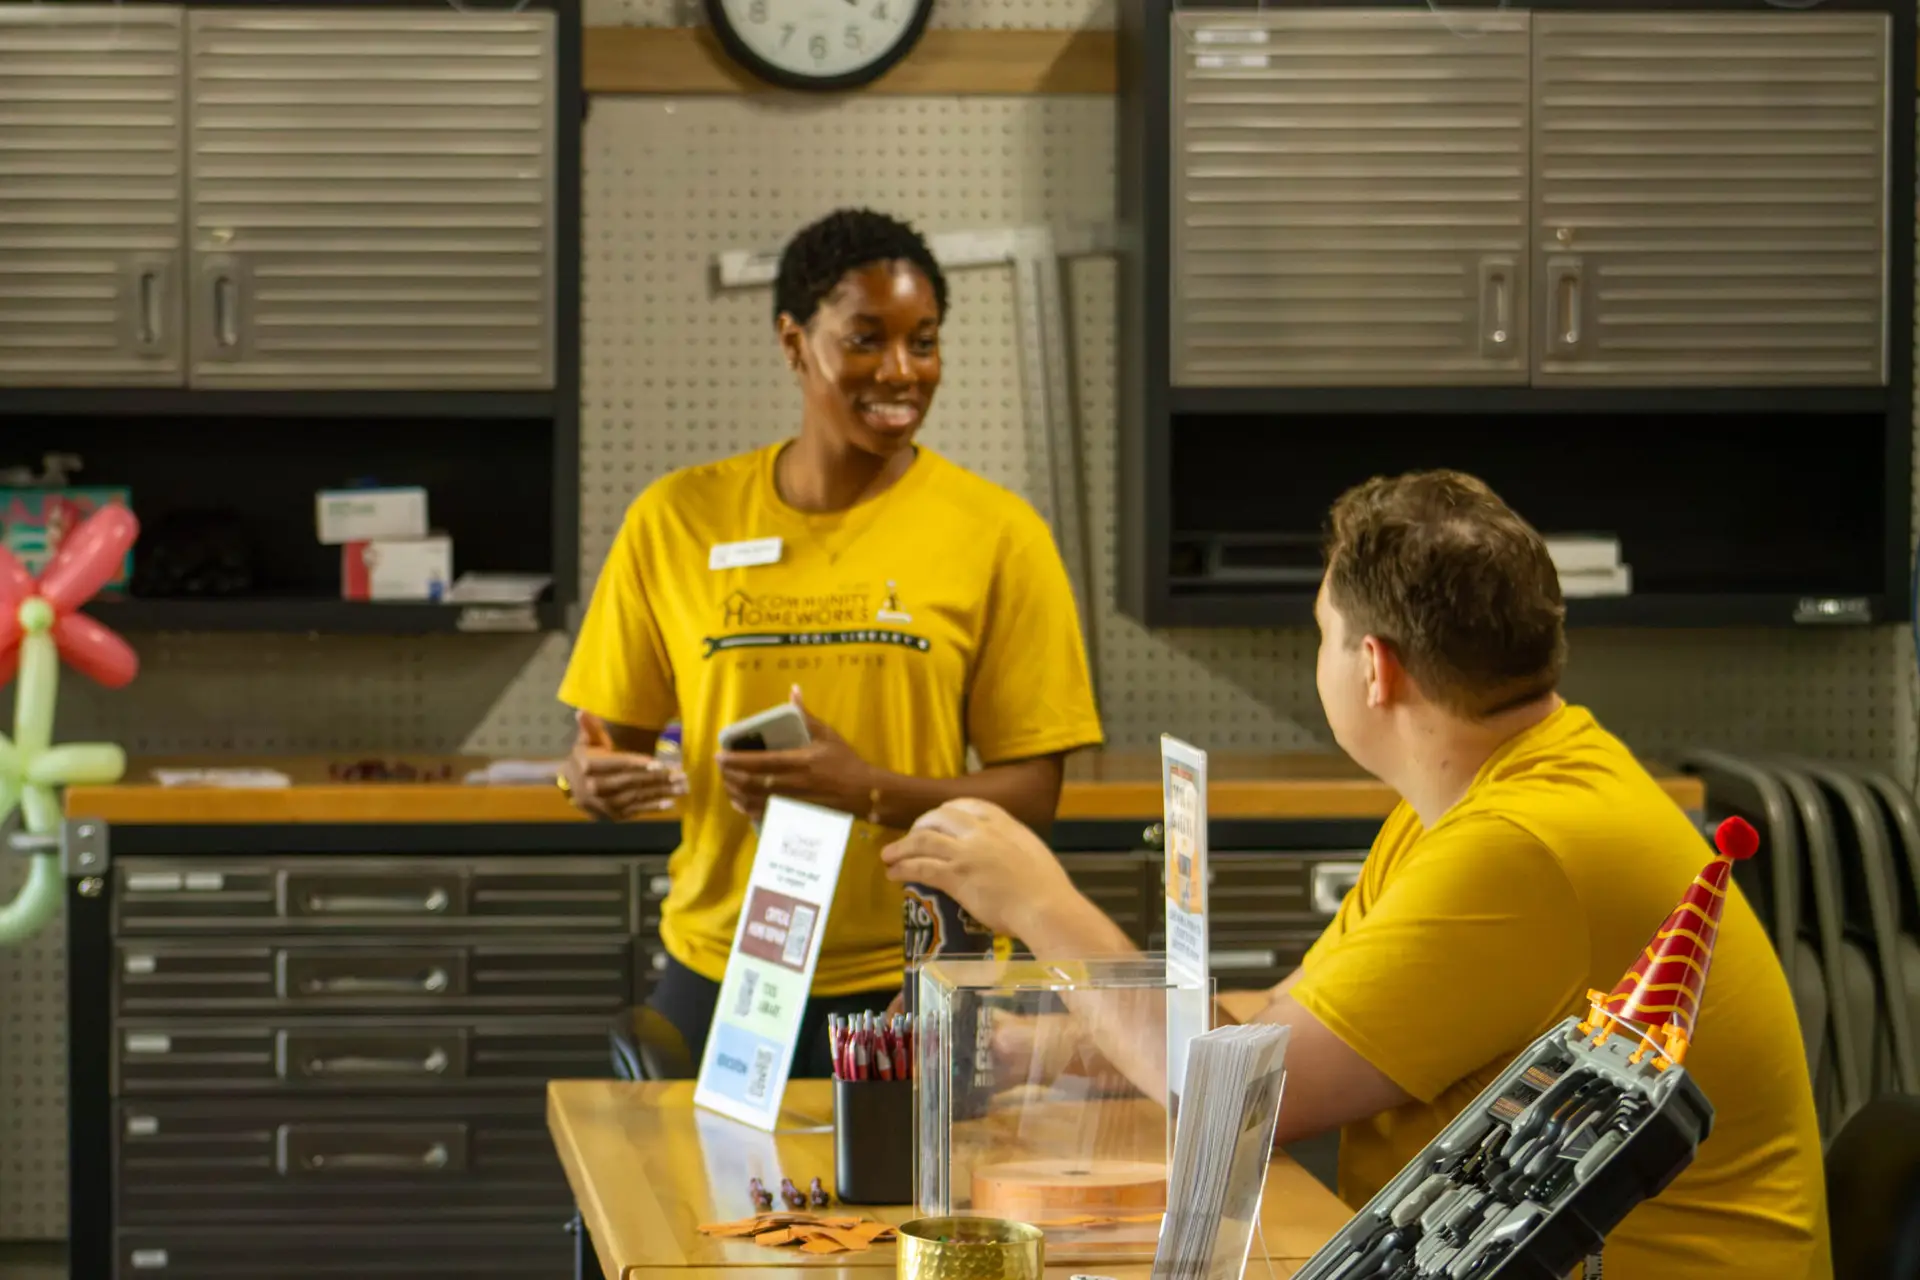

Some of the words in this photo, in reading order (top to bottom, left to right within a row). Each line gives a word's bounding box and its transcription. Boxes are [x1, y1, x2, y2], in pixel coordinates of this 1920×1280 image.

[749, 0, 767, 24] 8
[871, 2, 889, 21] 4
[780, 24, 795, 47] 7
[844, 26, 861, 49] 5
[808, 35, 827, 60] 6
